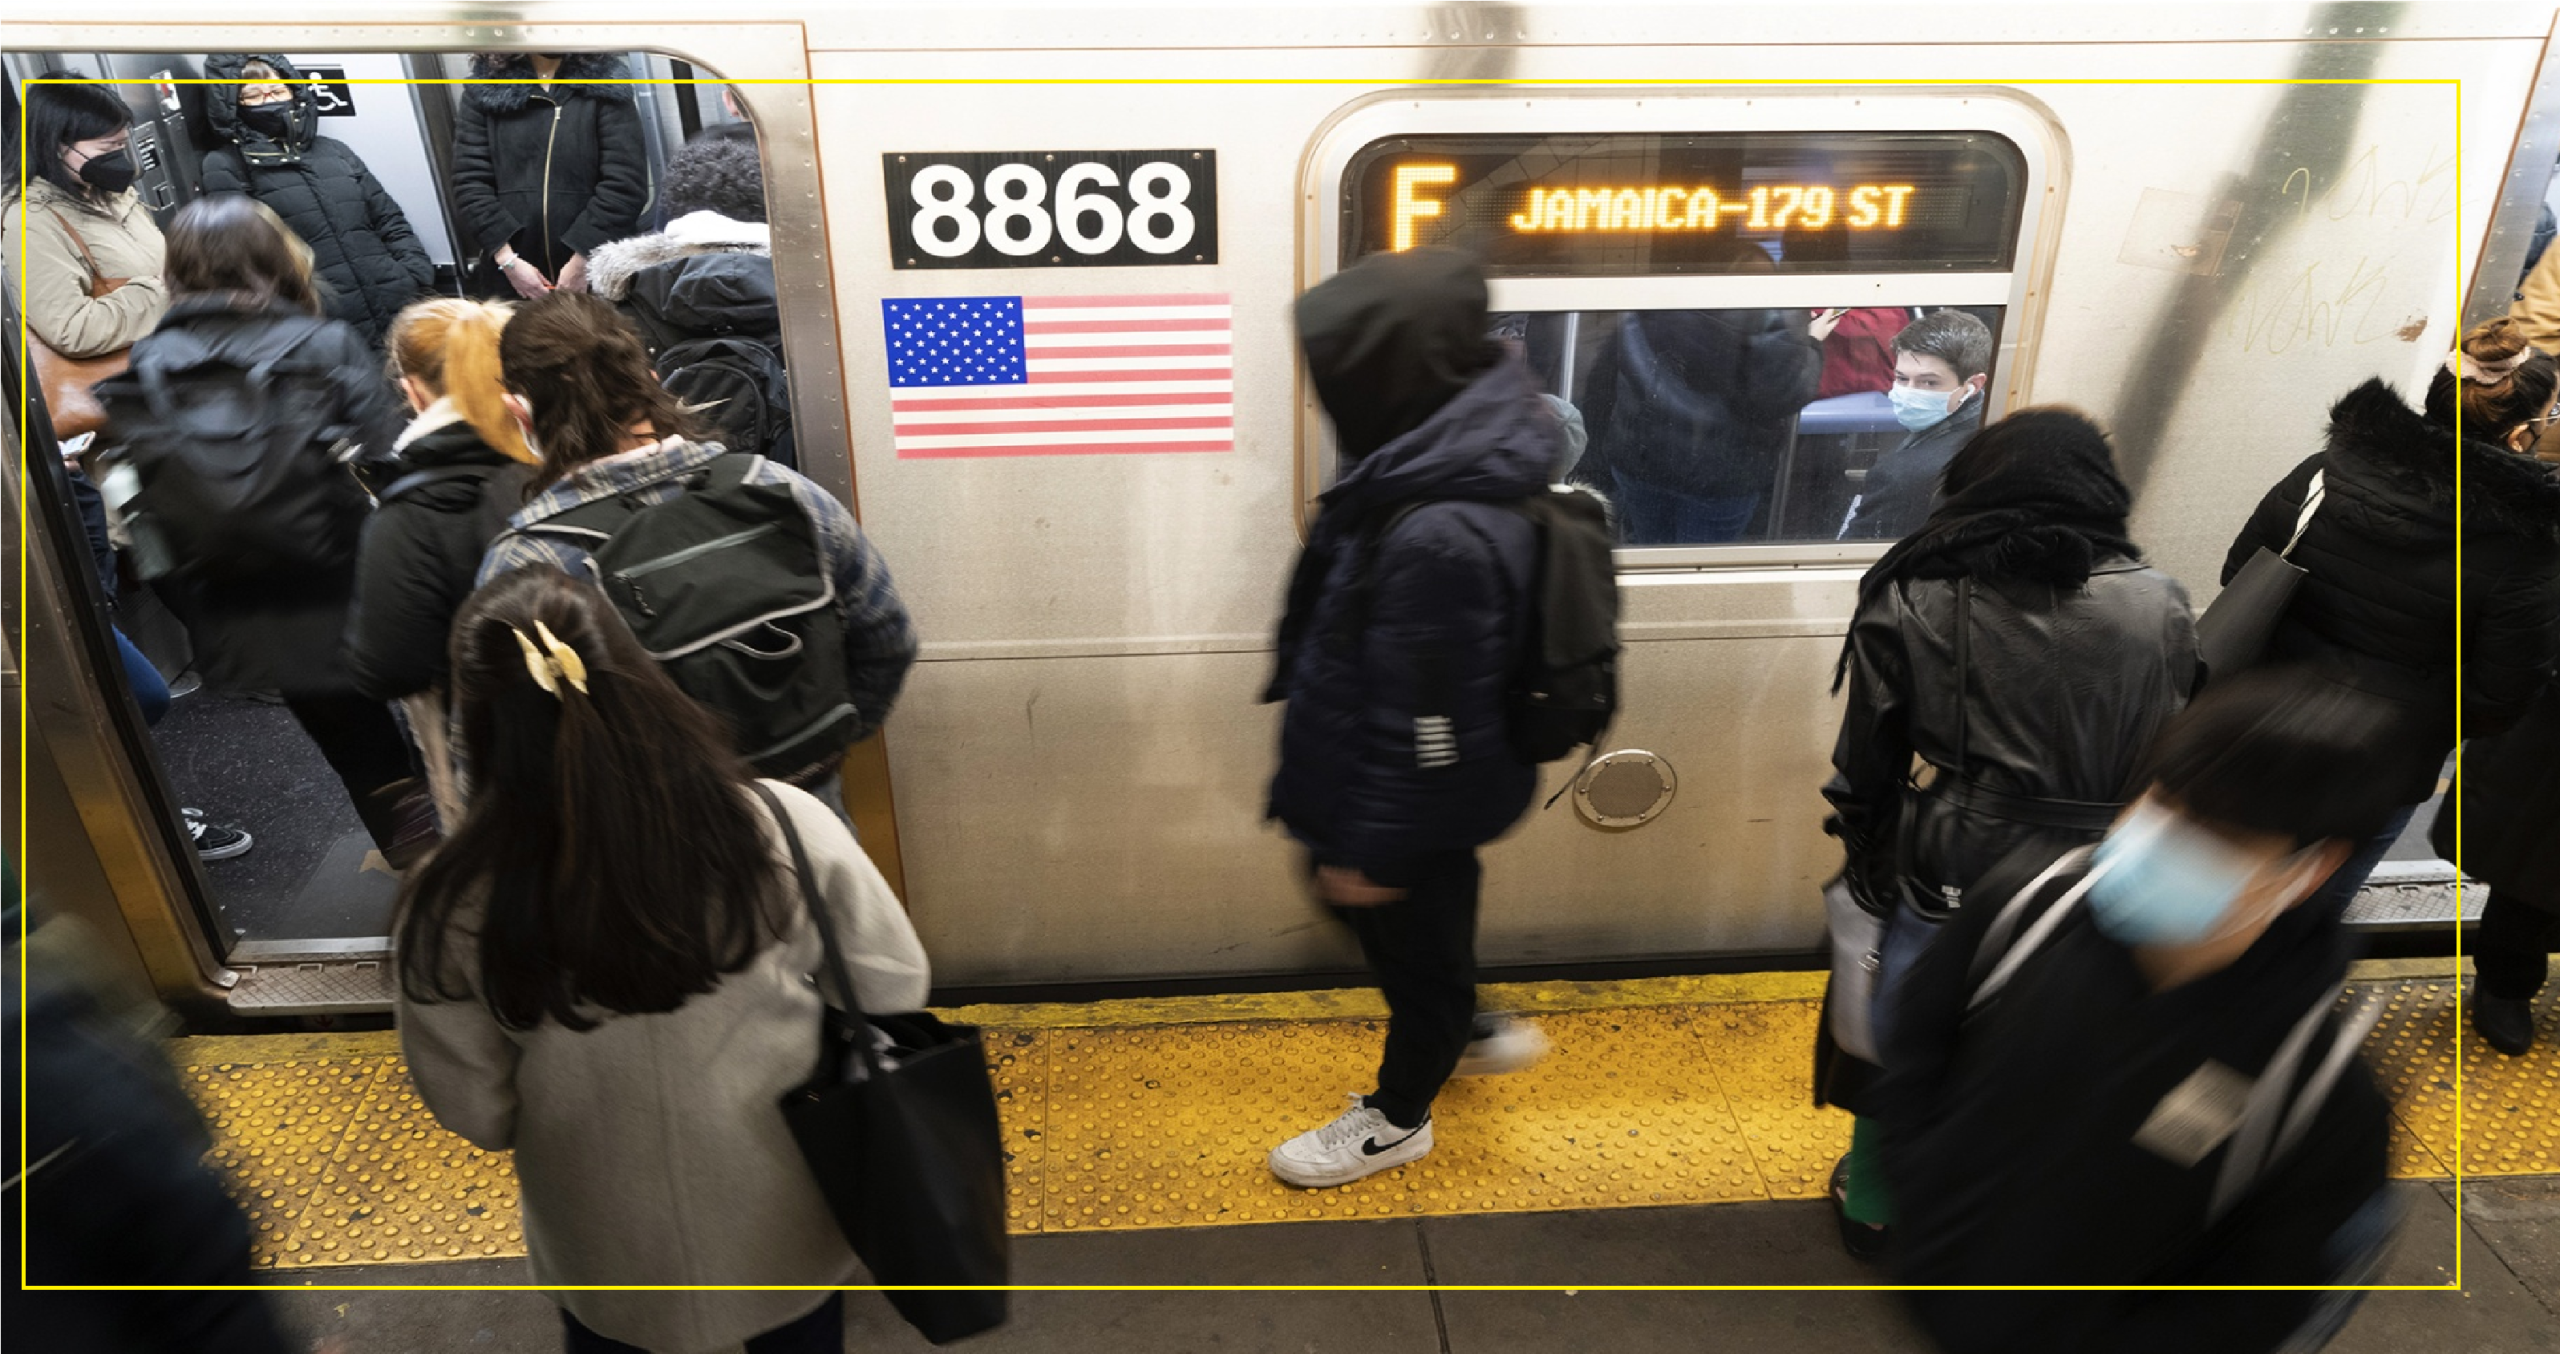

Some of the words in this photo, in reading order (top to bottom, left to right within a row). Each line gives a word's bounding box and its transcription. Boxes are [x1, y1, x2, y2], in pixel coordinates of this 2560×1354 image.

[910, 161, 1196, 257] 8868
[1394, 165, 1456, 252] F
[1510, 186, 1834, 230] JAMAICA-179
[1848, 184, 1915, 228] ST
